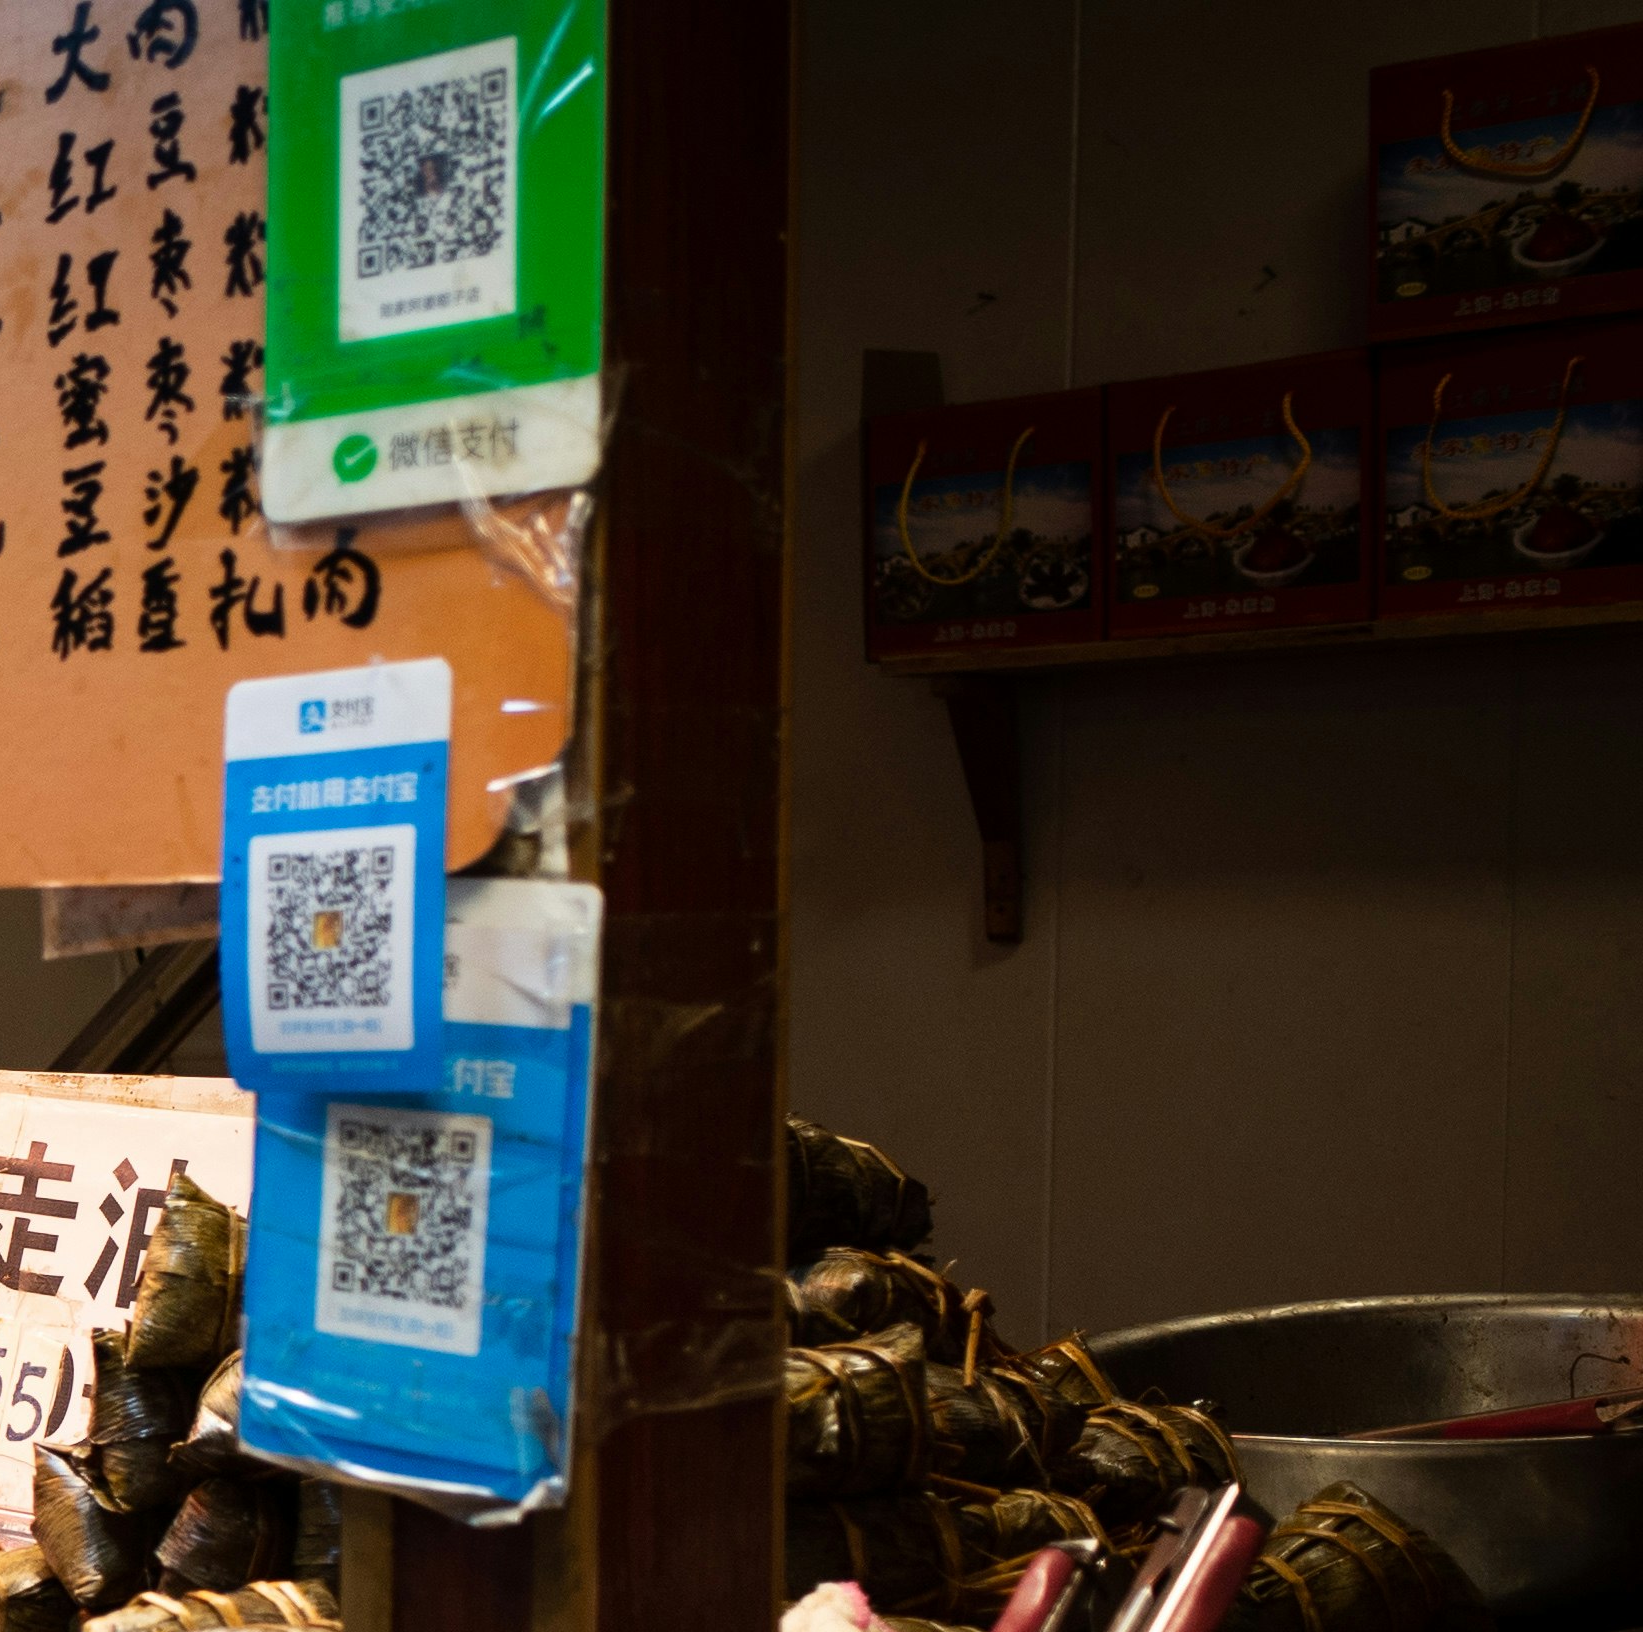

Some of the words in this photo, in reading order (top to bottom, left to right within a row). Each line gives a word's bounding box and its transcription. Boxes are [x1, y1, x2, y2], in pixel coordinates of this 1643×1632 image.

[388, 417, 520, 472] 微信支付
[445, 1057, 516, 1099] 付宝
